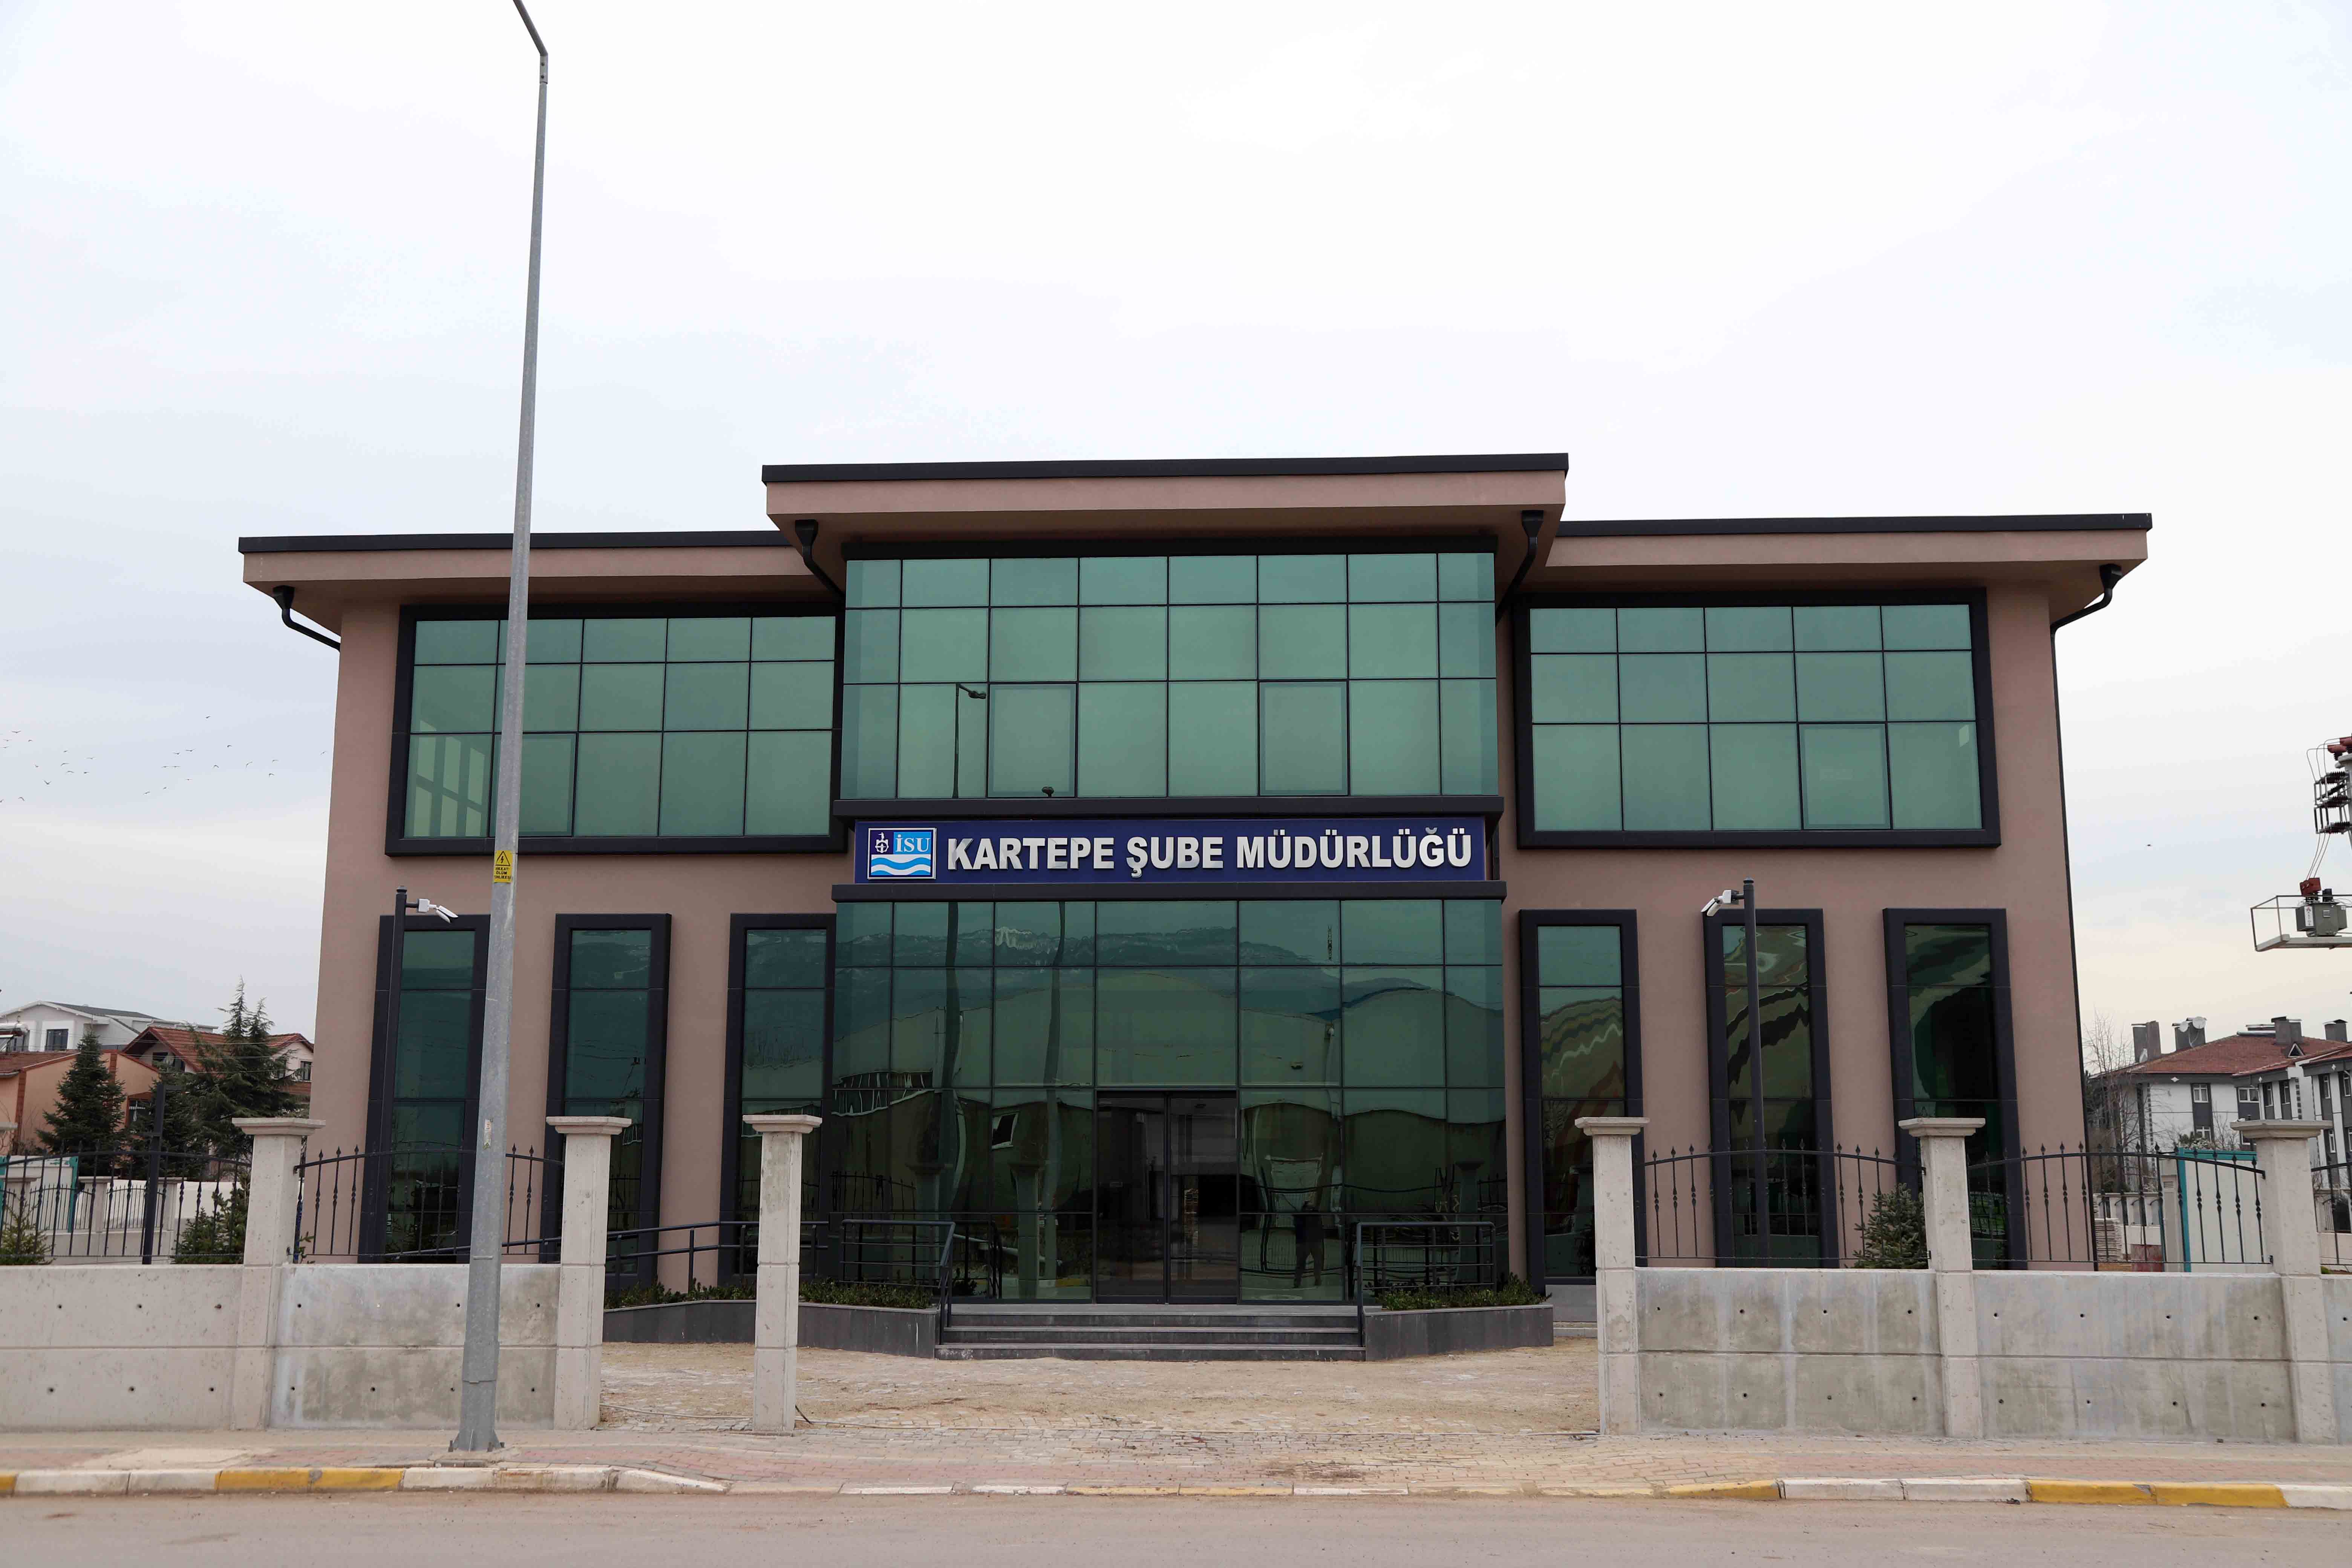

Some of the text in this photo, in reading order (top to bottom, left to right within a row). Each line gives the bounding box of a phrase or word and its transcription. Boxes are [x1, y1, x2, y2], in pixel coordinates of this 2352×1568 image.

[895, 834, 930, 852] İSU
[948, 827, 1472, 877] KARTEPE ŞUBE MÜDÜRLÜĞÜ
